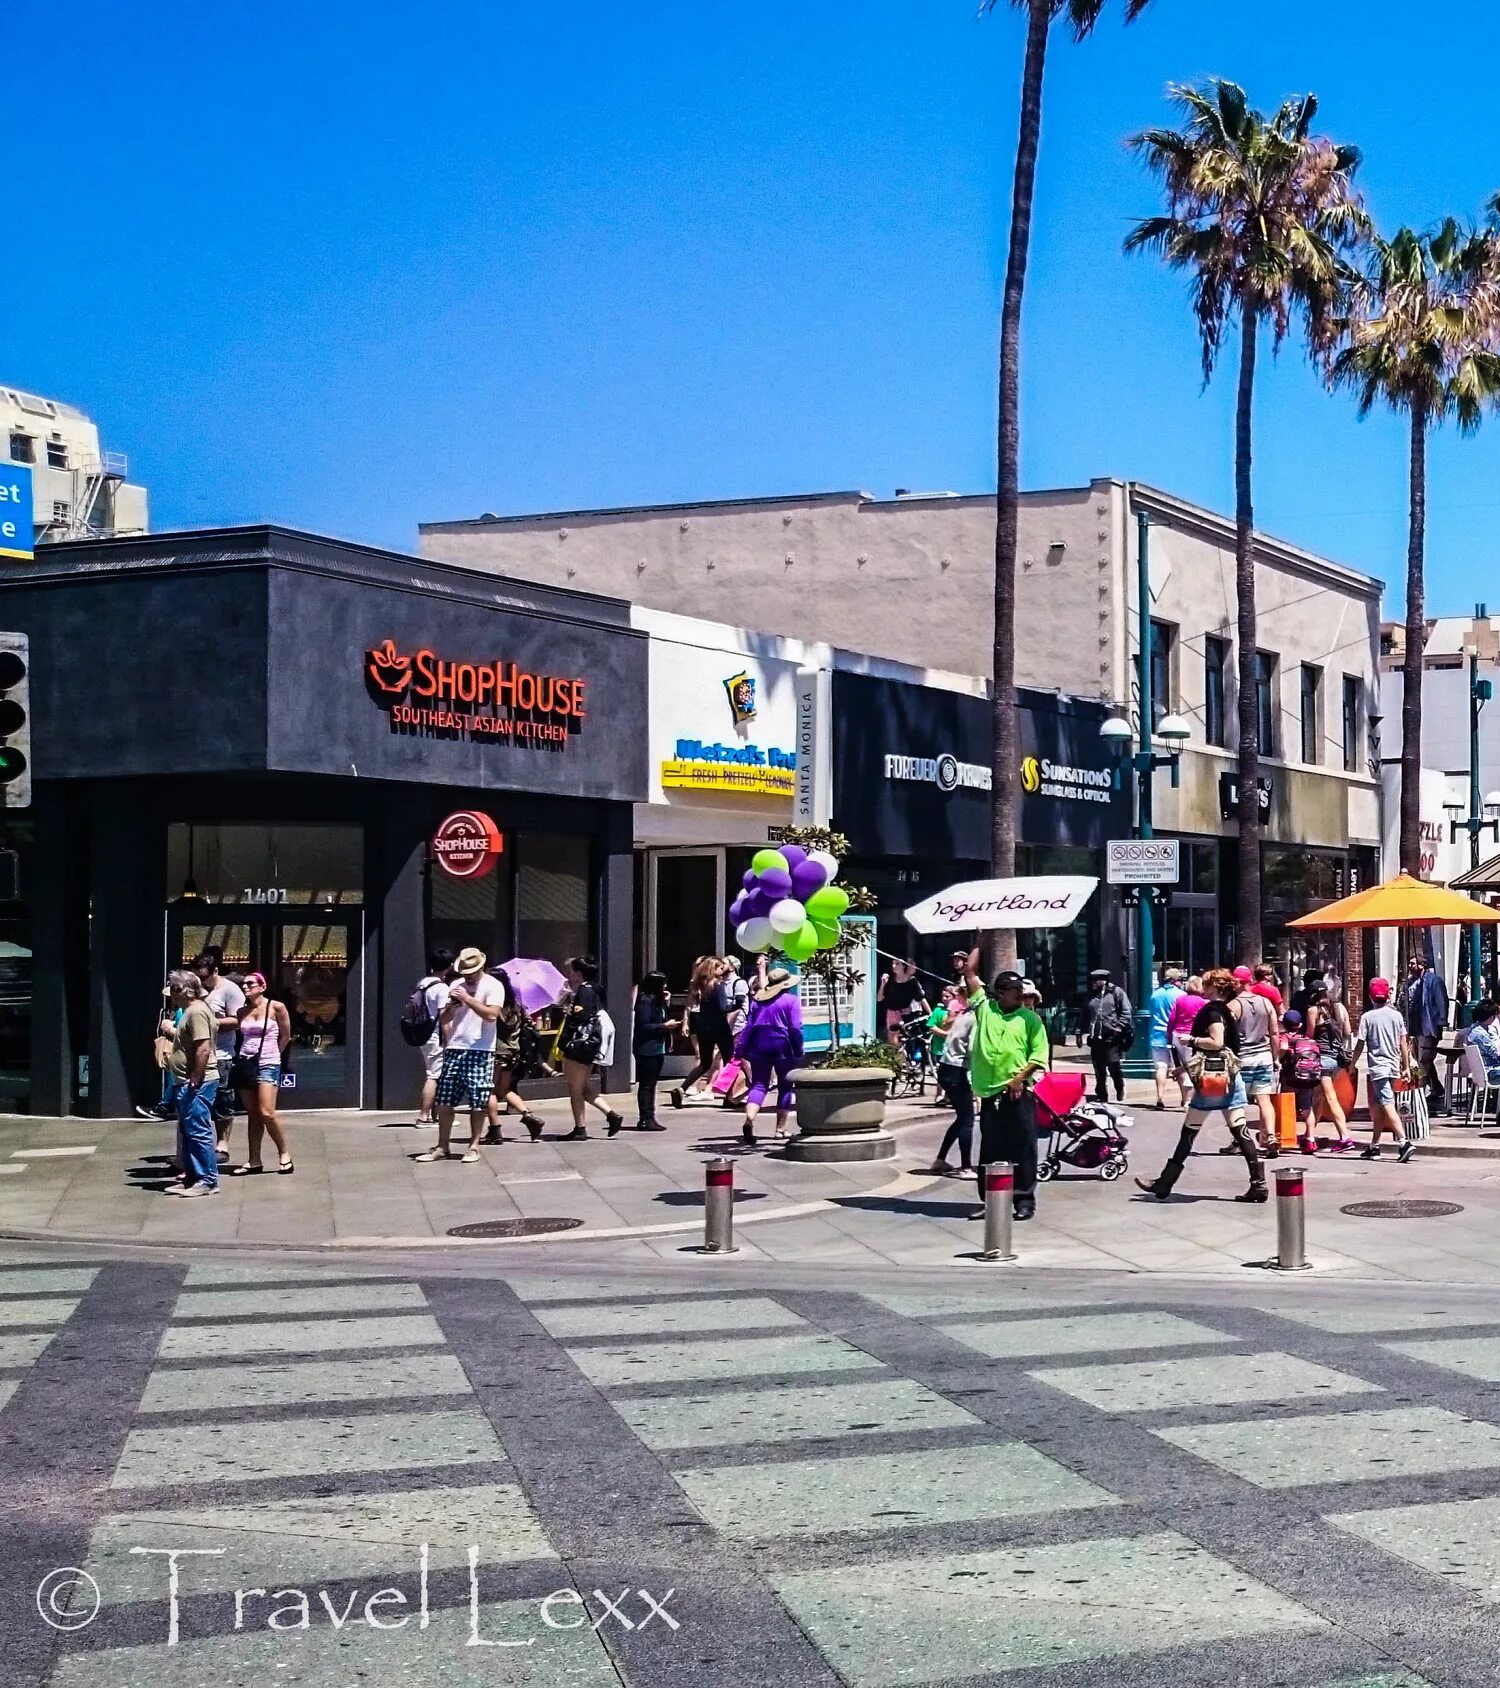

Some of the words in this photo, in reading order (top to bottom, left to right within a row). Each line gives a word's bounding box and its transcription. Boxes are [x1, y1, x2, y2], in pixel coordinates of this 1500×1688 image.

[415, 650, 587, 717] SHOPHOUSE
[393, 706, 470, 731] SOUTHEAST
[473, 716, 513, 736] ASIAN
[517, 722, 568, 742] KITCHEN
[802, 692, 813, 756] MONICA
[692, 768, 718, 784] FRESH
[884, 754, 938, 782] FOREVER
[1040, 758, 1112, 788] SUNSATIONS
[800, 764, 810, 815] SANTA
[1084, 789, 1112, 803] OPTICAL
[1419, 821, 1443, 843] ZZLE
[1420, 853, 1435, 872] OO
[240, 888, 290, 904] 1401
[932, 893, 1072, 922] Yogurtland
